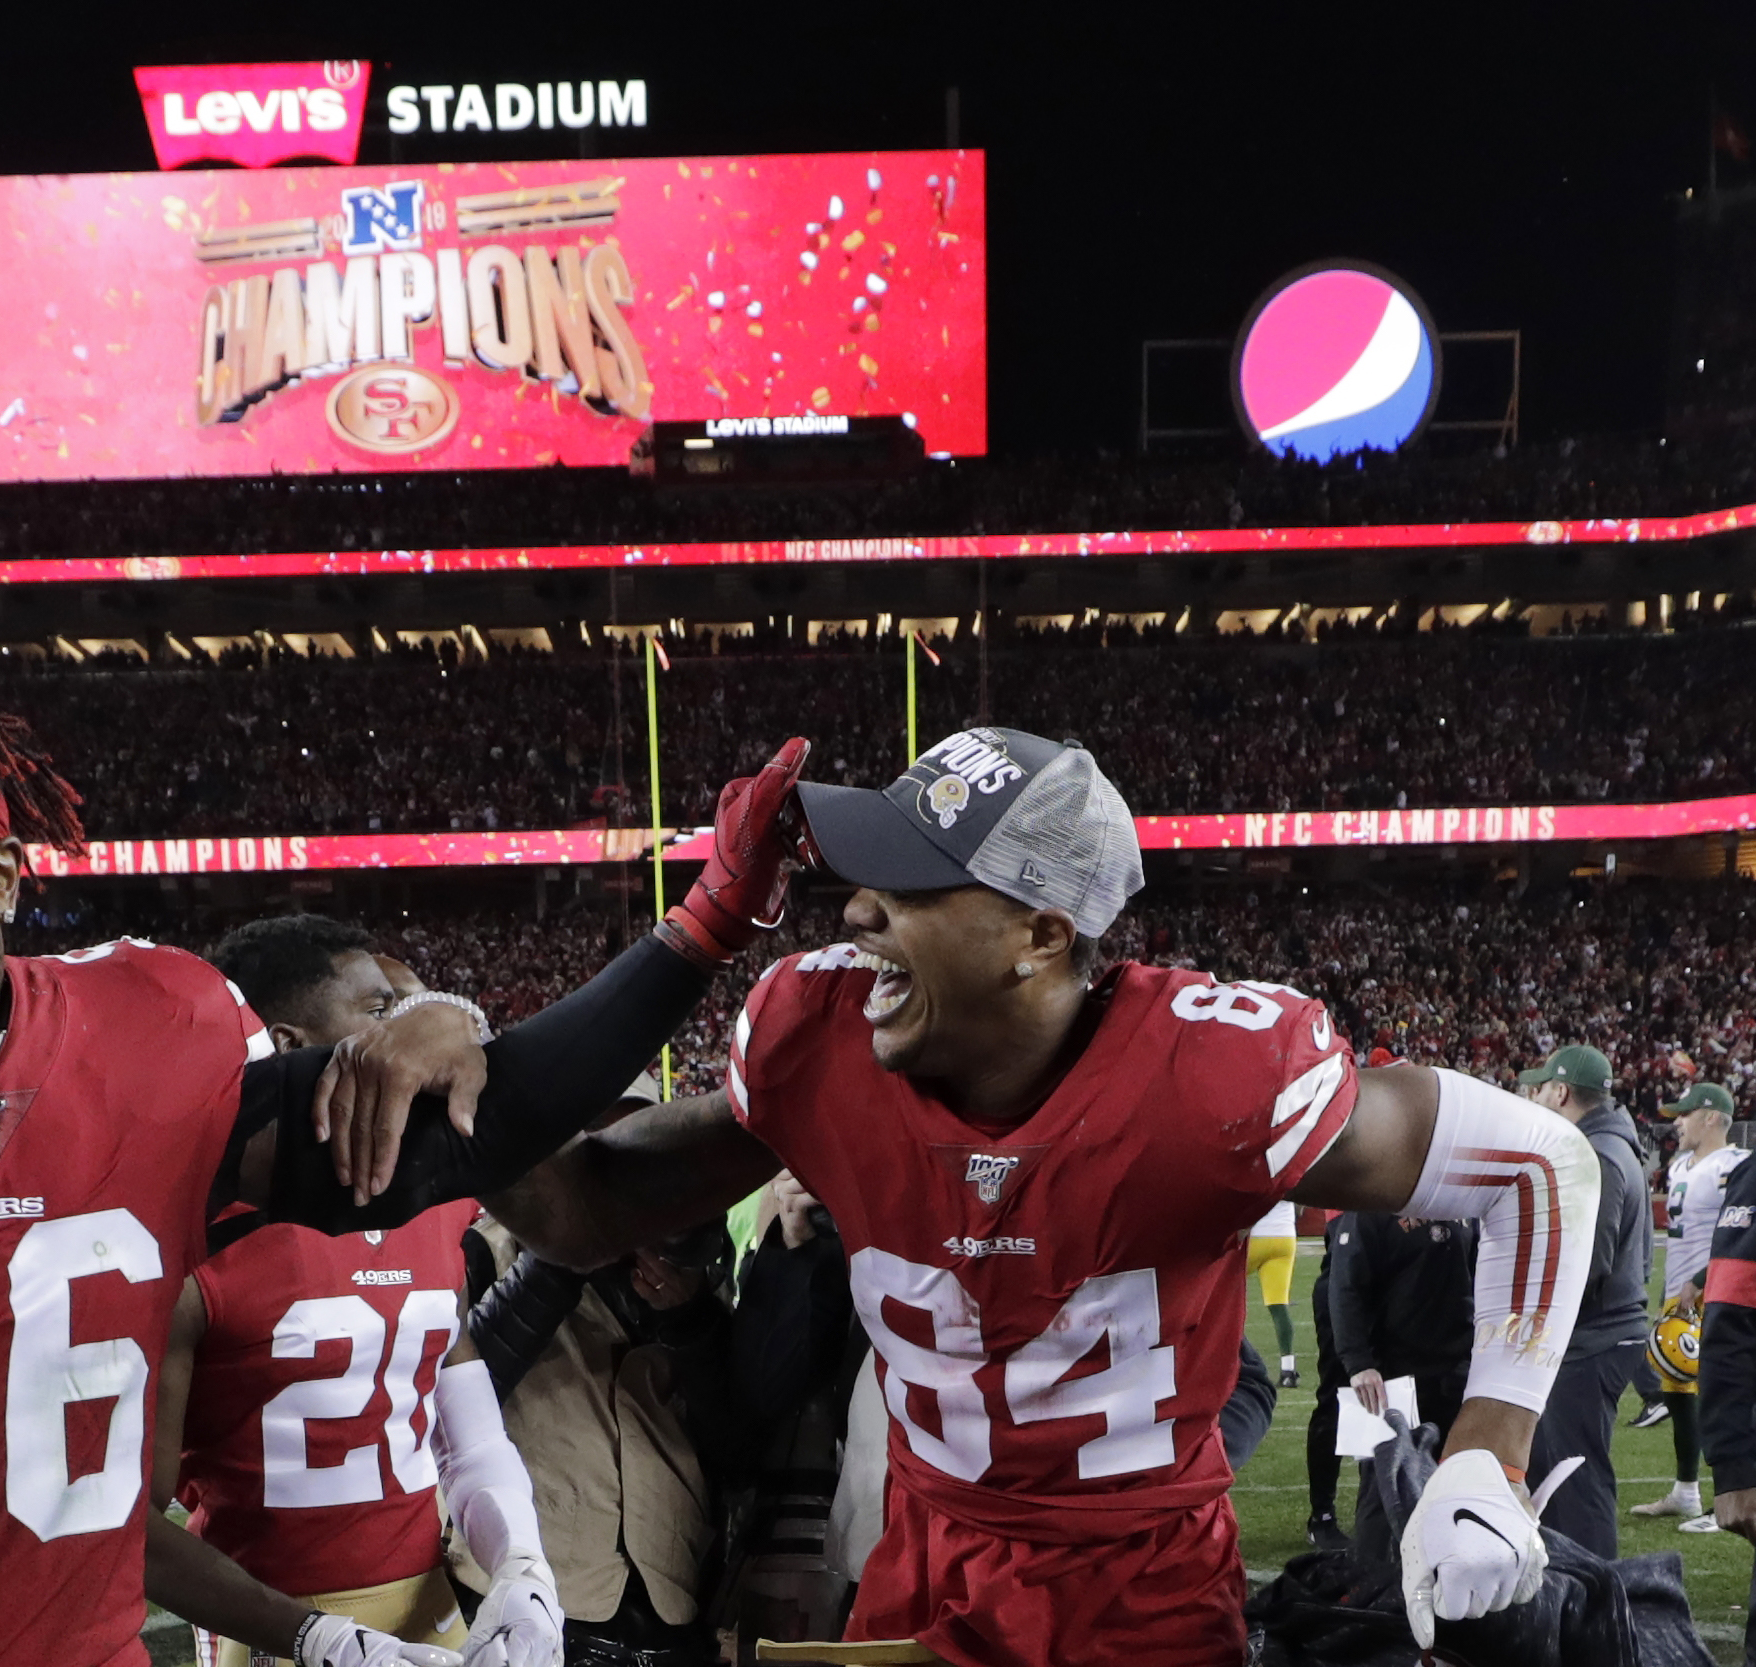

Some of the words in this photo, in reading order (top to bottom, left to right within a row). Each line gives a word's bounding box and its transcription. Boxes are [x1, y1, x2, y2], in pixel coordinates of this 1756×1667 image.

[386, 78, 648, 135] STADIUM
[197, 243, 651, 425] CHAMPIONS
[772, 414, 849, 435] STADIUM
[784, 540, 815, 561] NFC
[915, 731, 1022, 794] PIONS
[1245, 812, 1312, 848] NFC
[1334, 806, 1556, 846] CHAMPIONS
[27, 843, 69, 877] FC
[89, 835, 309, 875] CHAMPIONS
[942, 1236, 1036, 1258] 49ERS
[351, 1269, 413, 1286] 49ERS
[850, 1246, 1177, 1483] 84
[261, 1289, 460, 1508] 20
